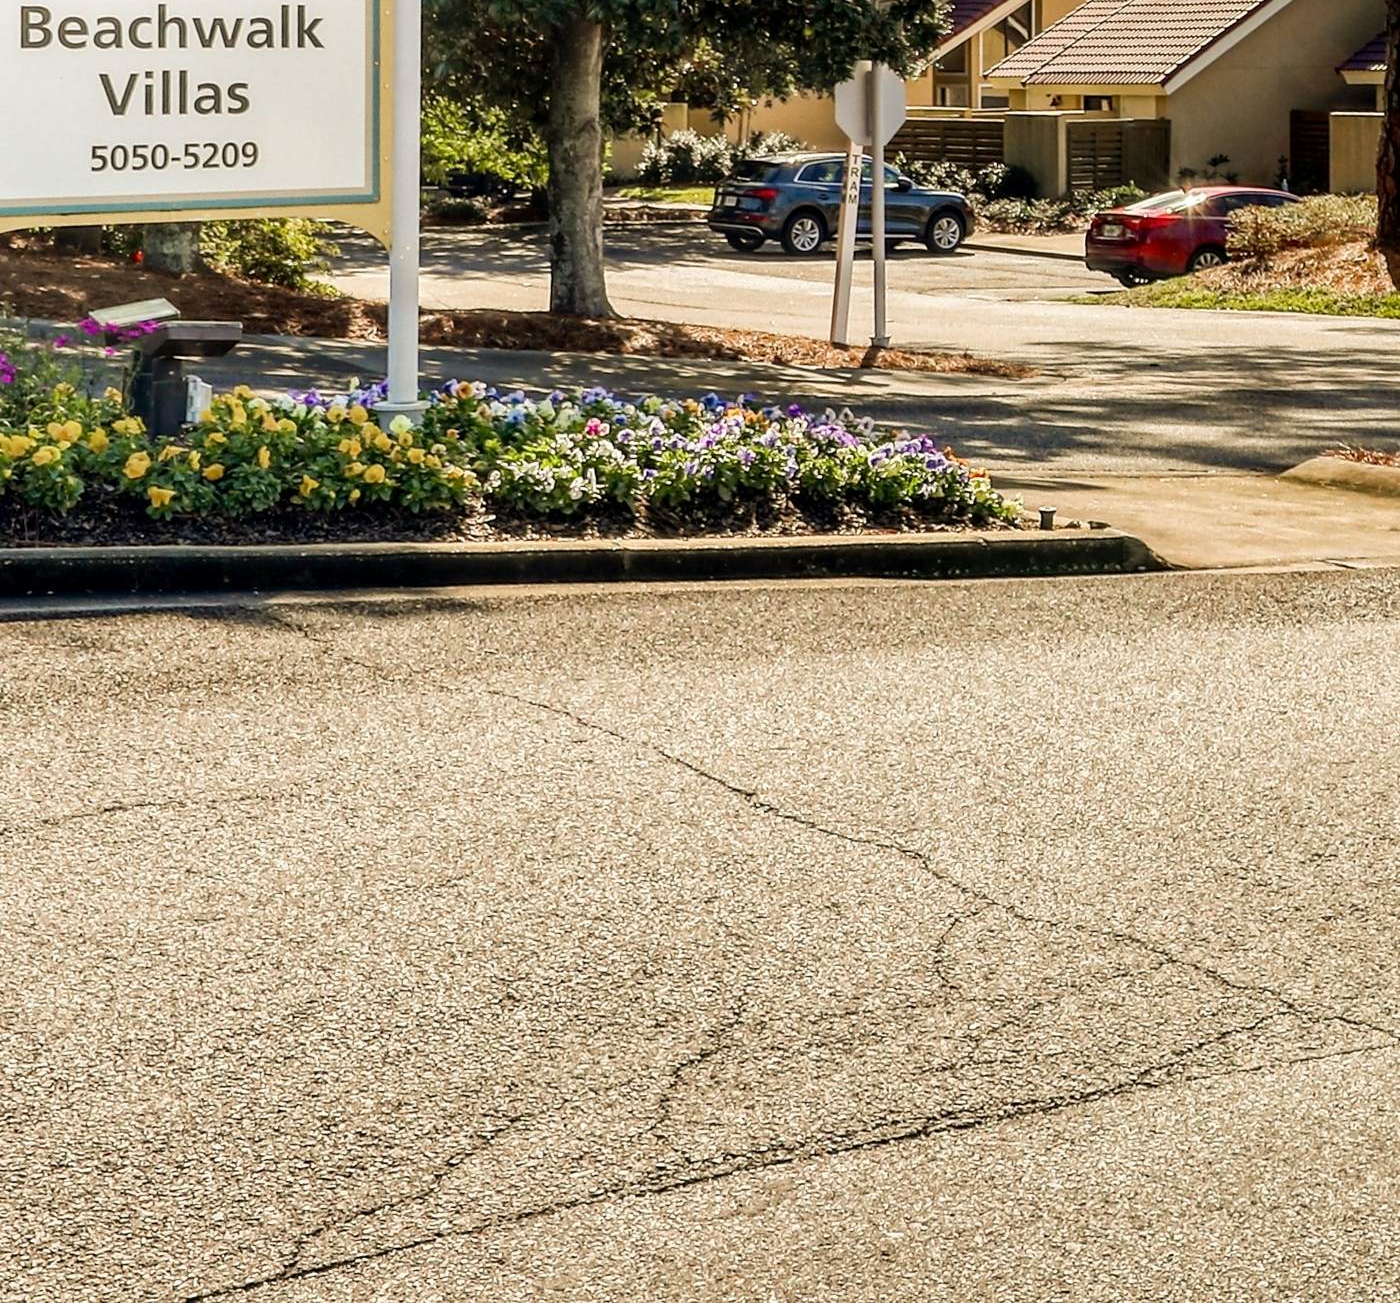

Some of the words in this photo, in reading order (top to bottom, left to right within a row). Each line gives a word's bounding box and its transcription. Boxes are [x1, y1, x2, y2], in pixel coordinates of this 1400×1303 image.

[20, 3, 324, 49] Beachwalk
[99, 70, 250, 116] Villas
[91, 141, 259, 172] 5050-5209
[848, 154, 860, 204] TRAM
